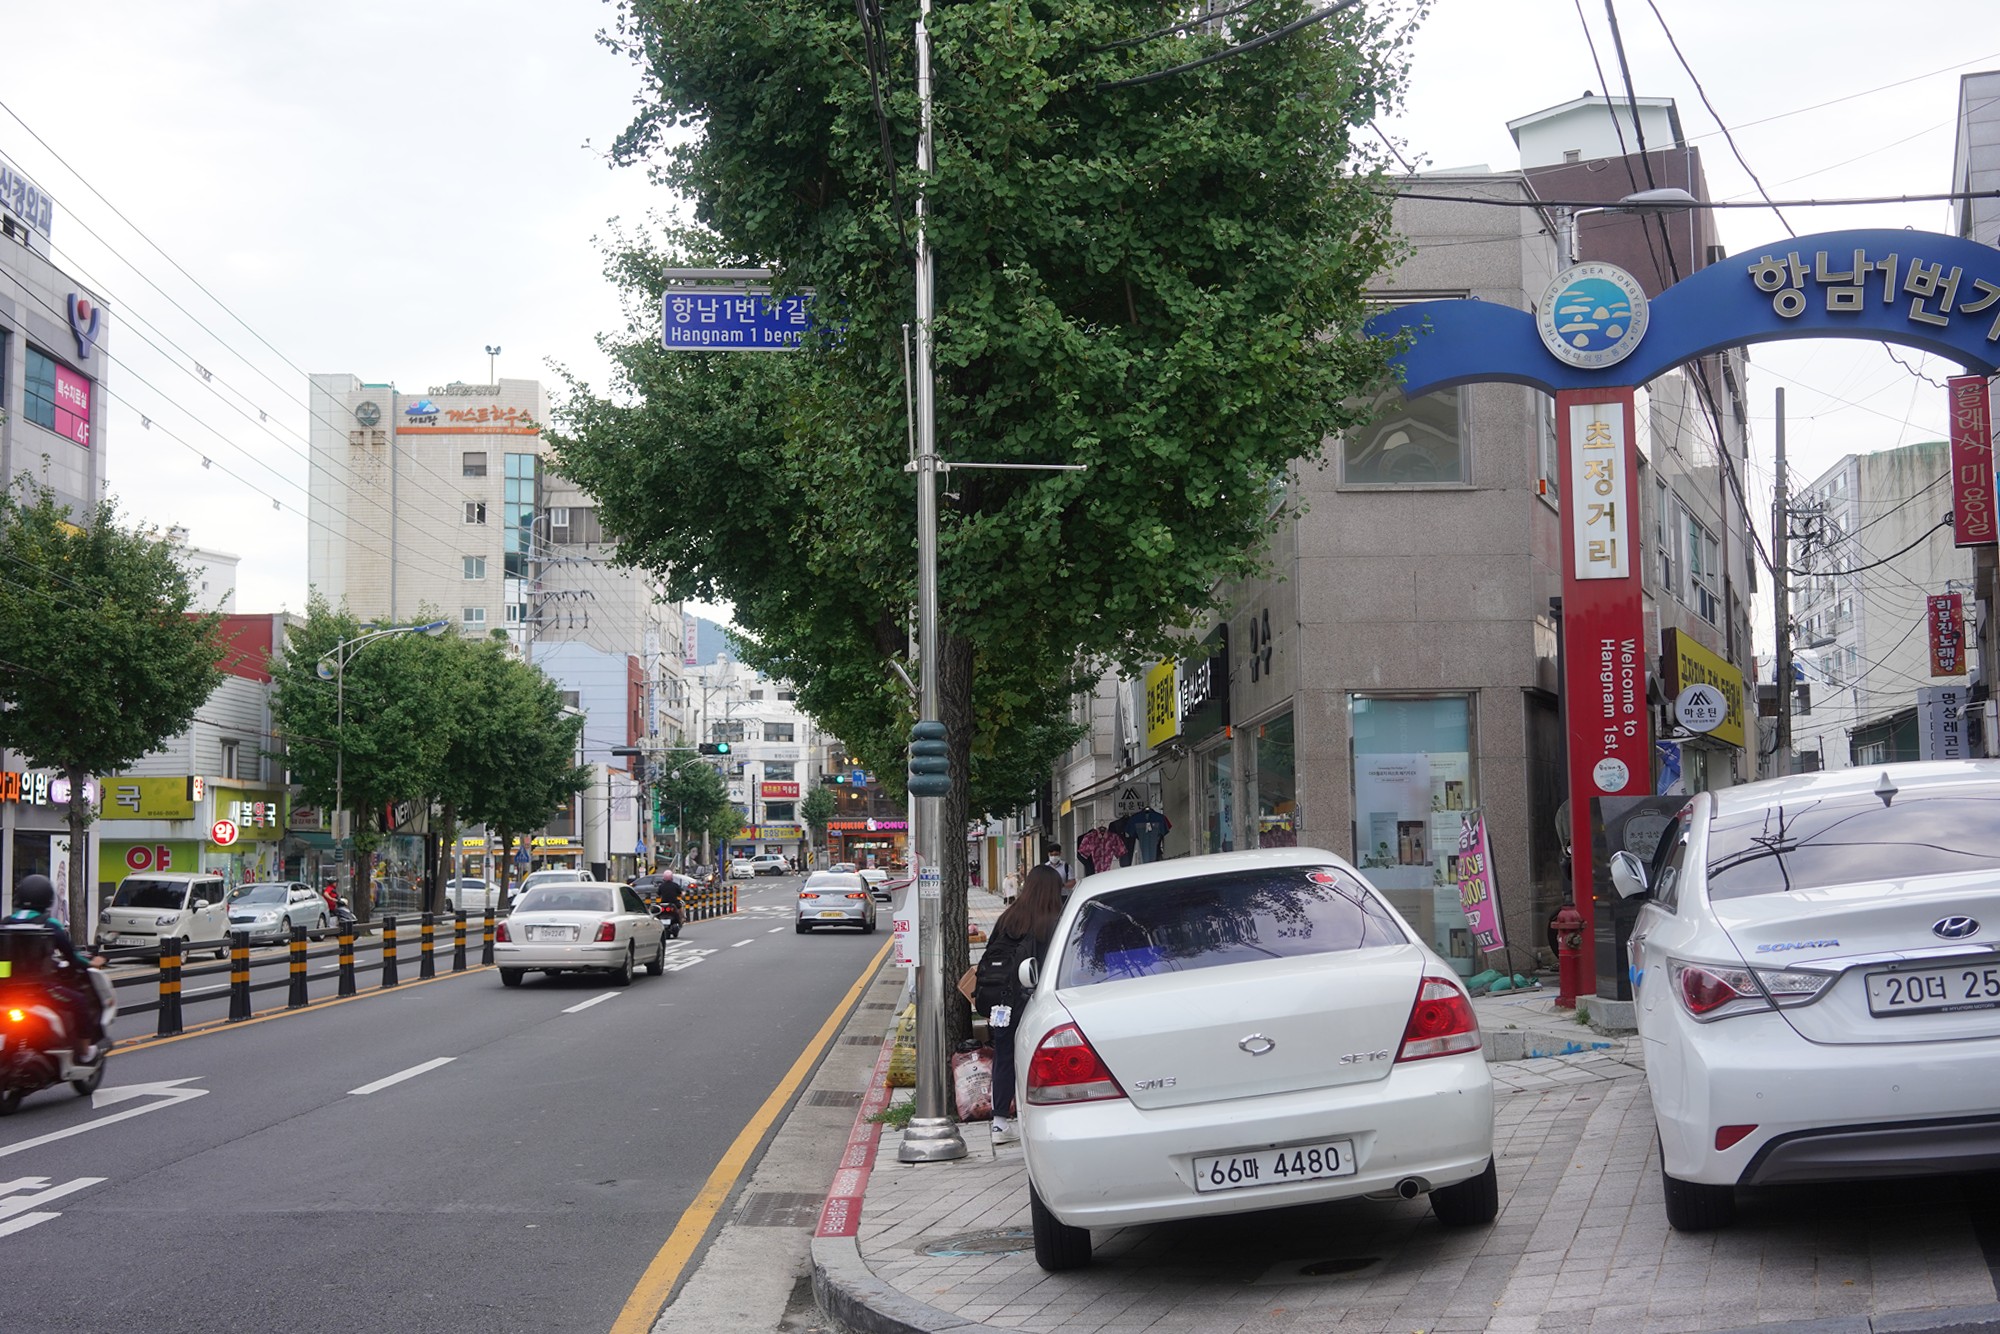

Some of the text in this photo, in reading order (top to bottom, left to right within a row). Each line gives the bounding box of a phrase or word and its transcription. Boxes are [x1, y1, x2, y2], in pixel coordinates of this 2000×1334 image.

[1543, 267, 1642, 343] THE LAND OF SEA TONGYEONG
[671, 326, 744, 345] Hangnam
[751, 327, 757, 342] 1
[1958, 383, 1990, 536] 클래식 미용실
[1583, 421, 1616, 568] 초정거리
[1600, 639, 1615, 718] Hangnam
[1621, 638, 1637, 737] Welcome to
[1684, 708, 1717, 718] 마운틴
[1604, 725, 1618, 755] 1st.
[215, 823, 233, 842] 약
[1756, 938, 1840, 953] SONATA
[1886, 974, 1947, 1005] 20더
[1133, 1076, 1177, 1092] SM3
[1210, 1146, 1341, 1186] 66마 4480
